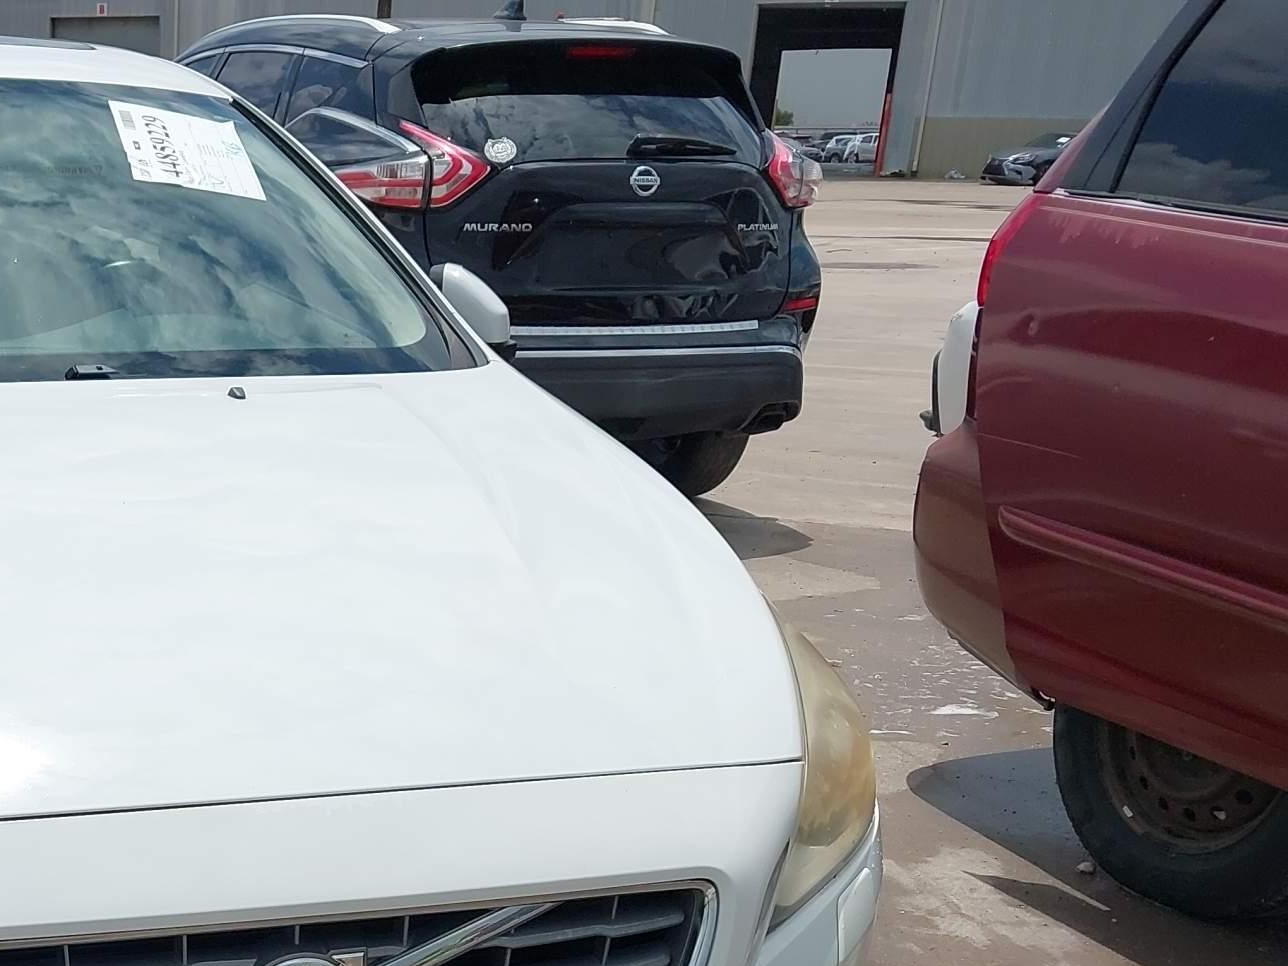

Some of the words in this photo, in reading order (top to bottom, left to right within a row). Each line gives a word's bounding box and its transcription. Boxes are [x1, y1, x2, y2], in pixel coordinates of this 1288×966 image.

[141, 115, 183, 178] 44859229
[463, 223, 533, 232] MURANO
[737, 223, 779, 231] PLATINUM
